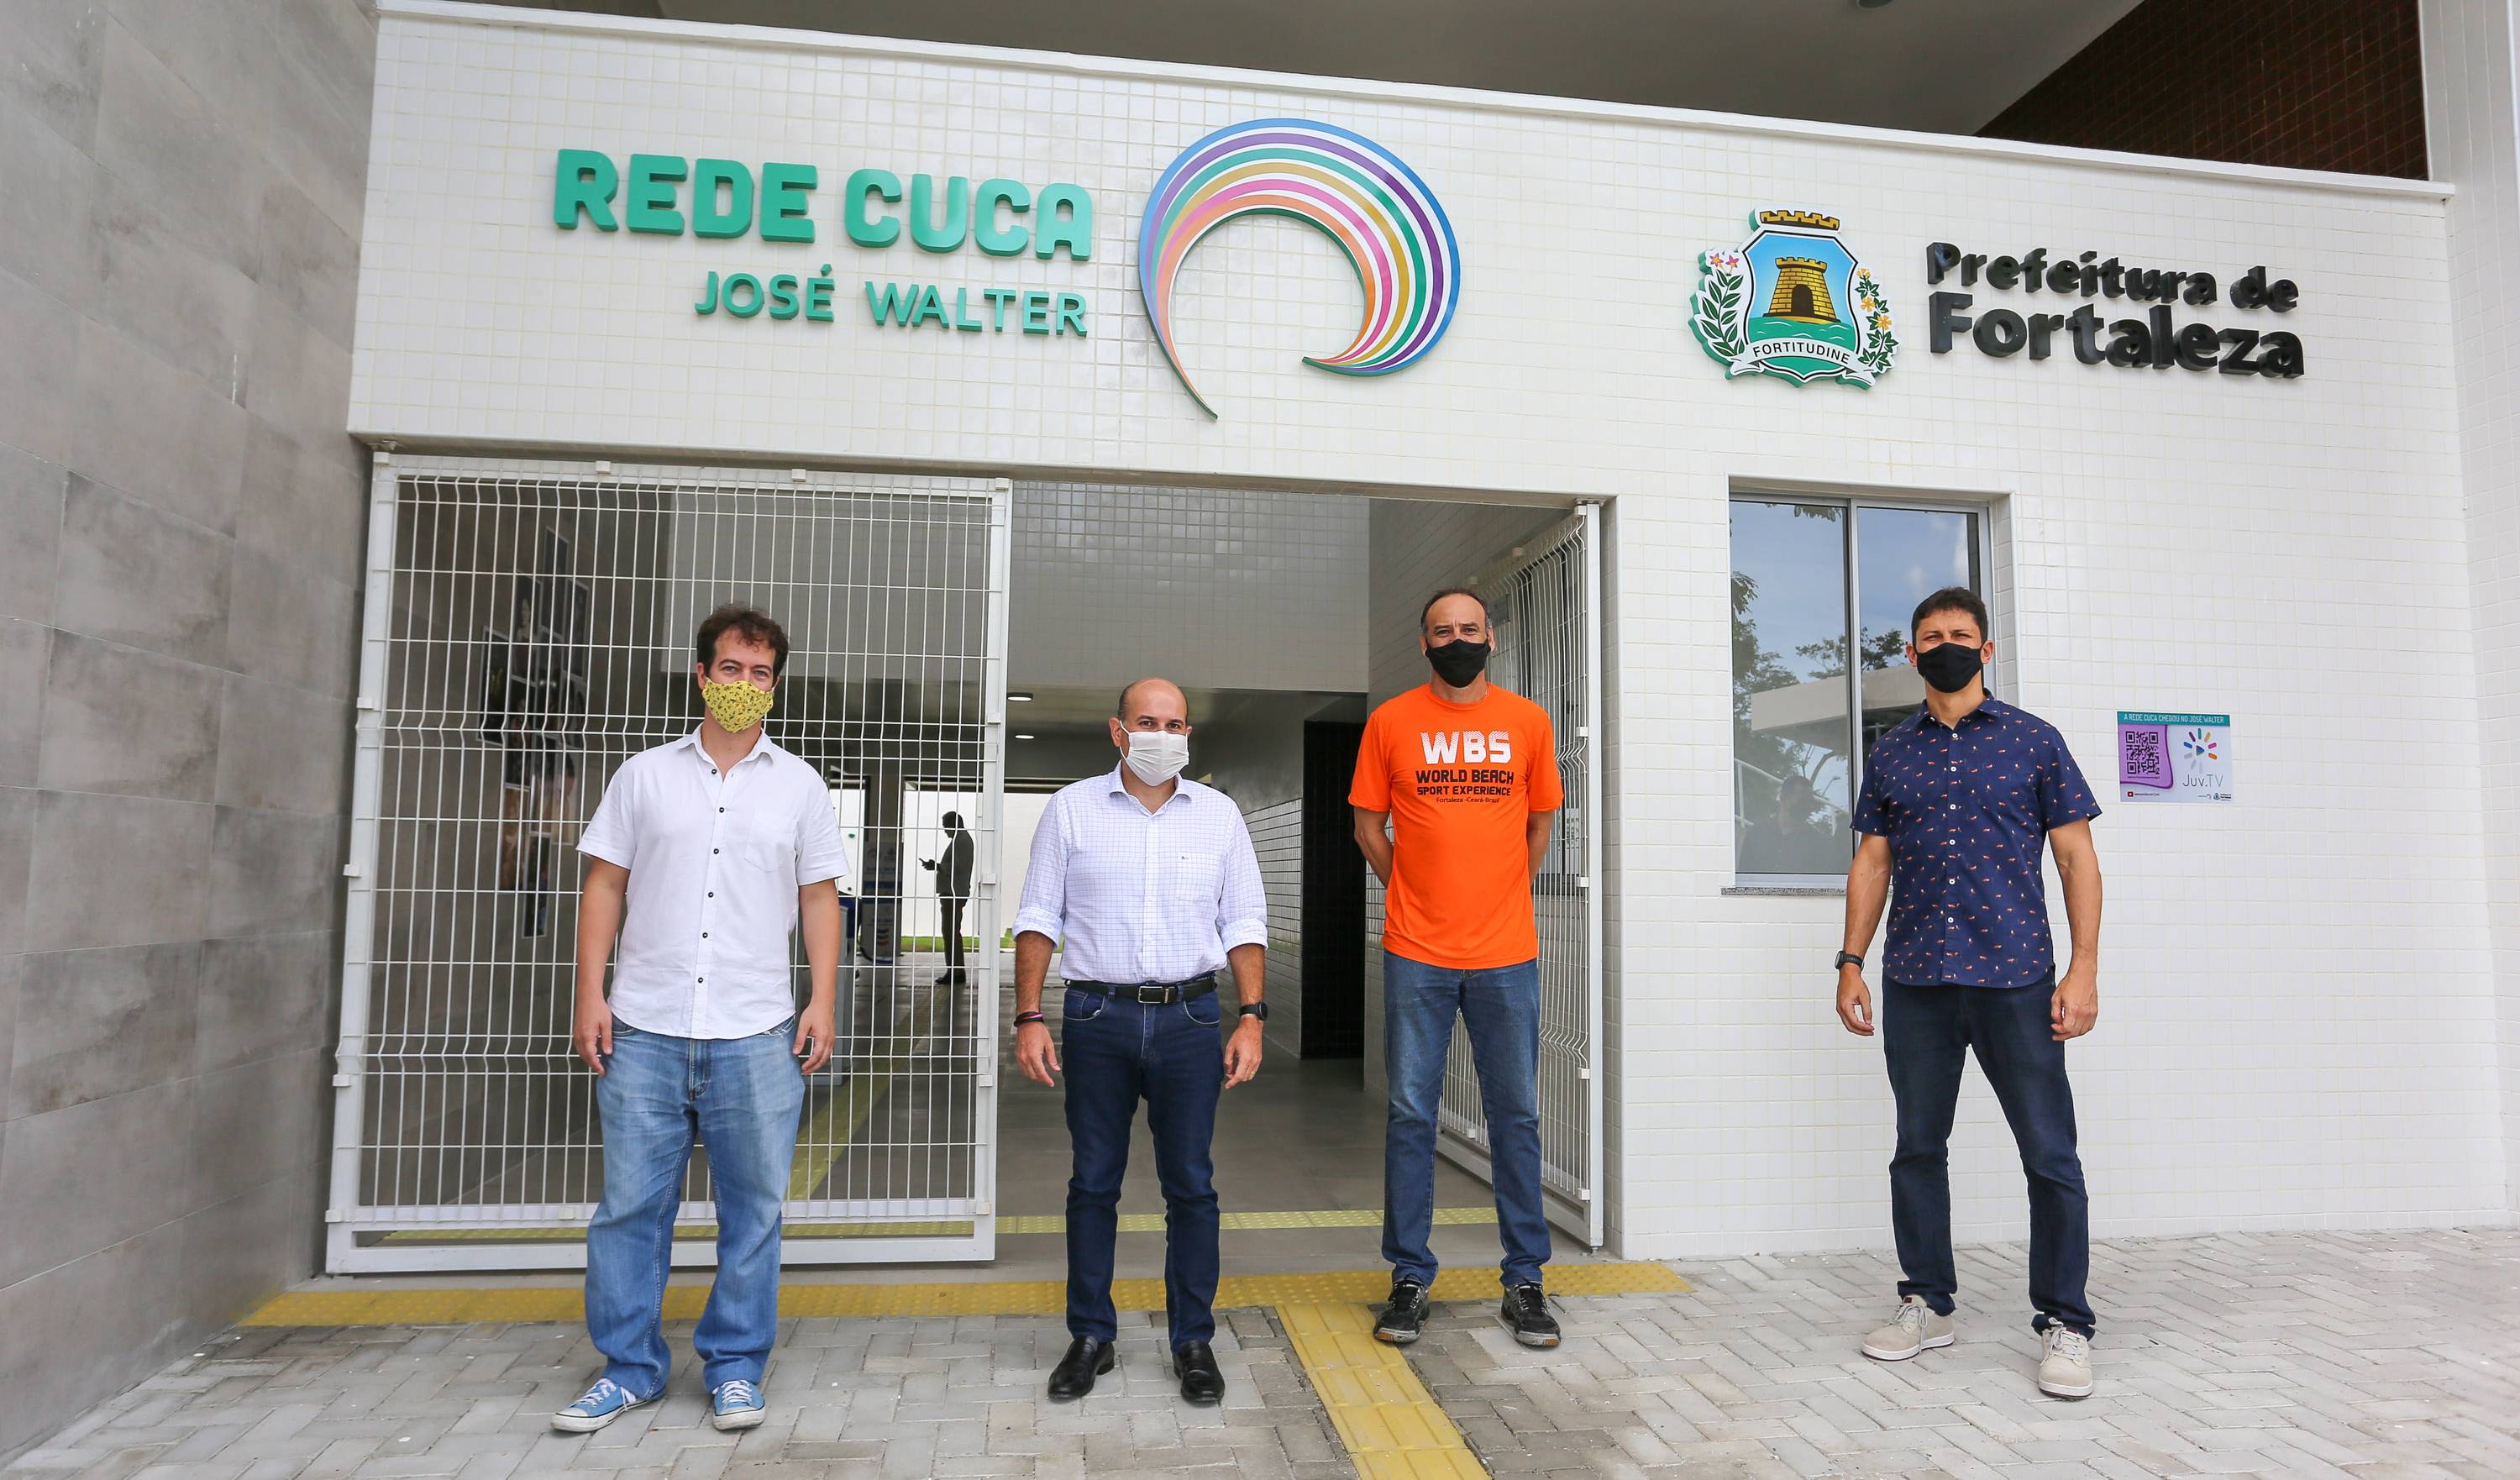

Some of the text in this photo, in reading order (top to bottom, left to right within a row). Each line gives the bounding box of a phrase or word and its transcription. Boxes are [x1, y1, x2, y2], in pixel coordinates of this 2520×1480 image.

[554, 149, 1093, 261] REDE CUCA
[1926, 241, 2300, 313] Prefeitura de
[695, 263, 1088, 337] JOSÉ WALTER
[1929, 291, 2305, 379] Fortaleza
[1752, 341, 1851, 365] FORTITUDINE
[2203, 716, 2224, 724] WALTER
[1420, 730, 1512, 764] WBS
[1415, 769, 1515, 785] WORLD BEACH
[1417, 785, 1511, 795] SPORT EXPERIENCE
[2183, 774, 2224, 787] Juv.TV
